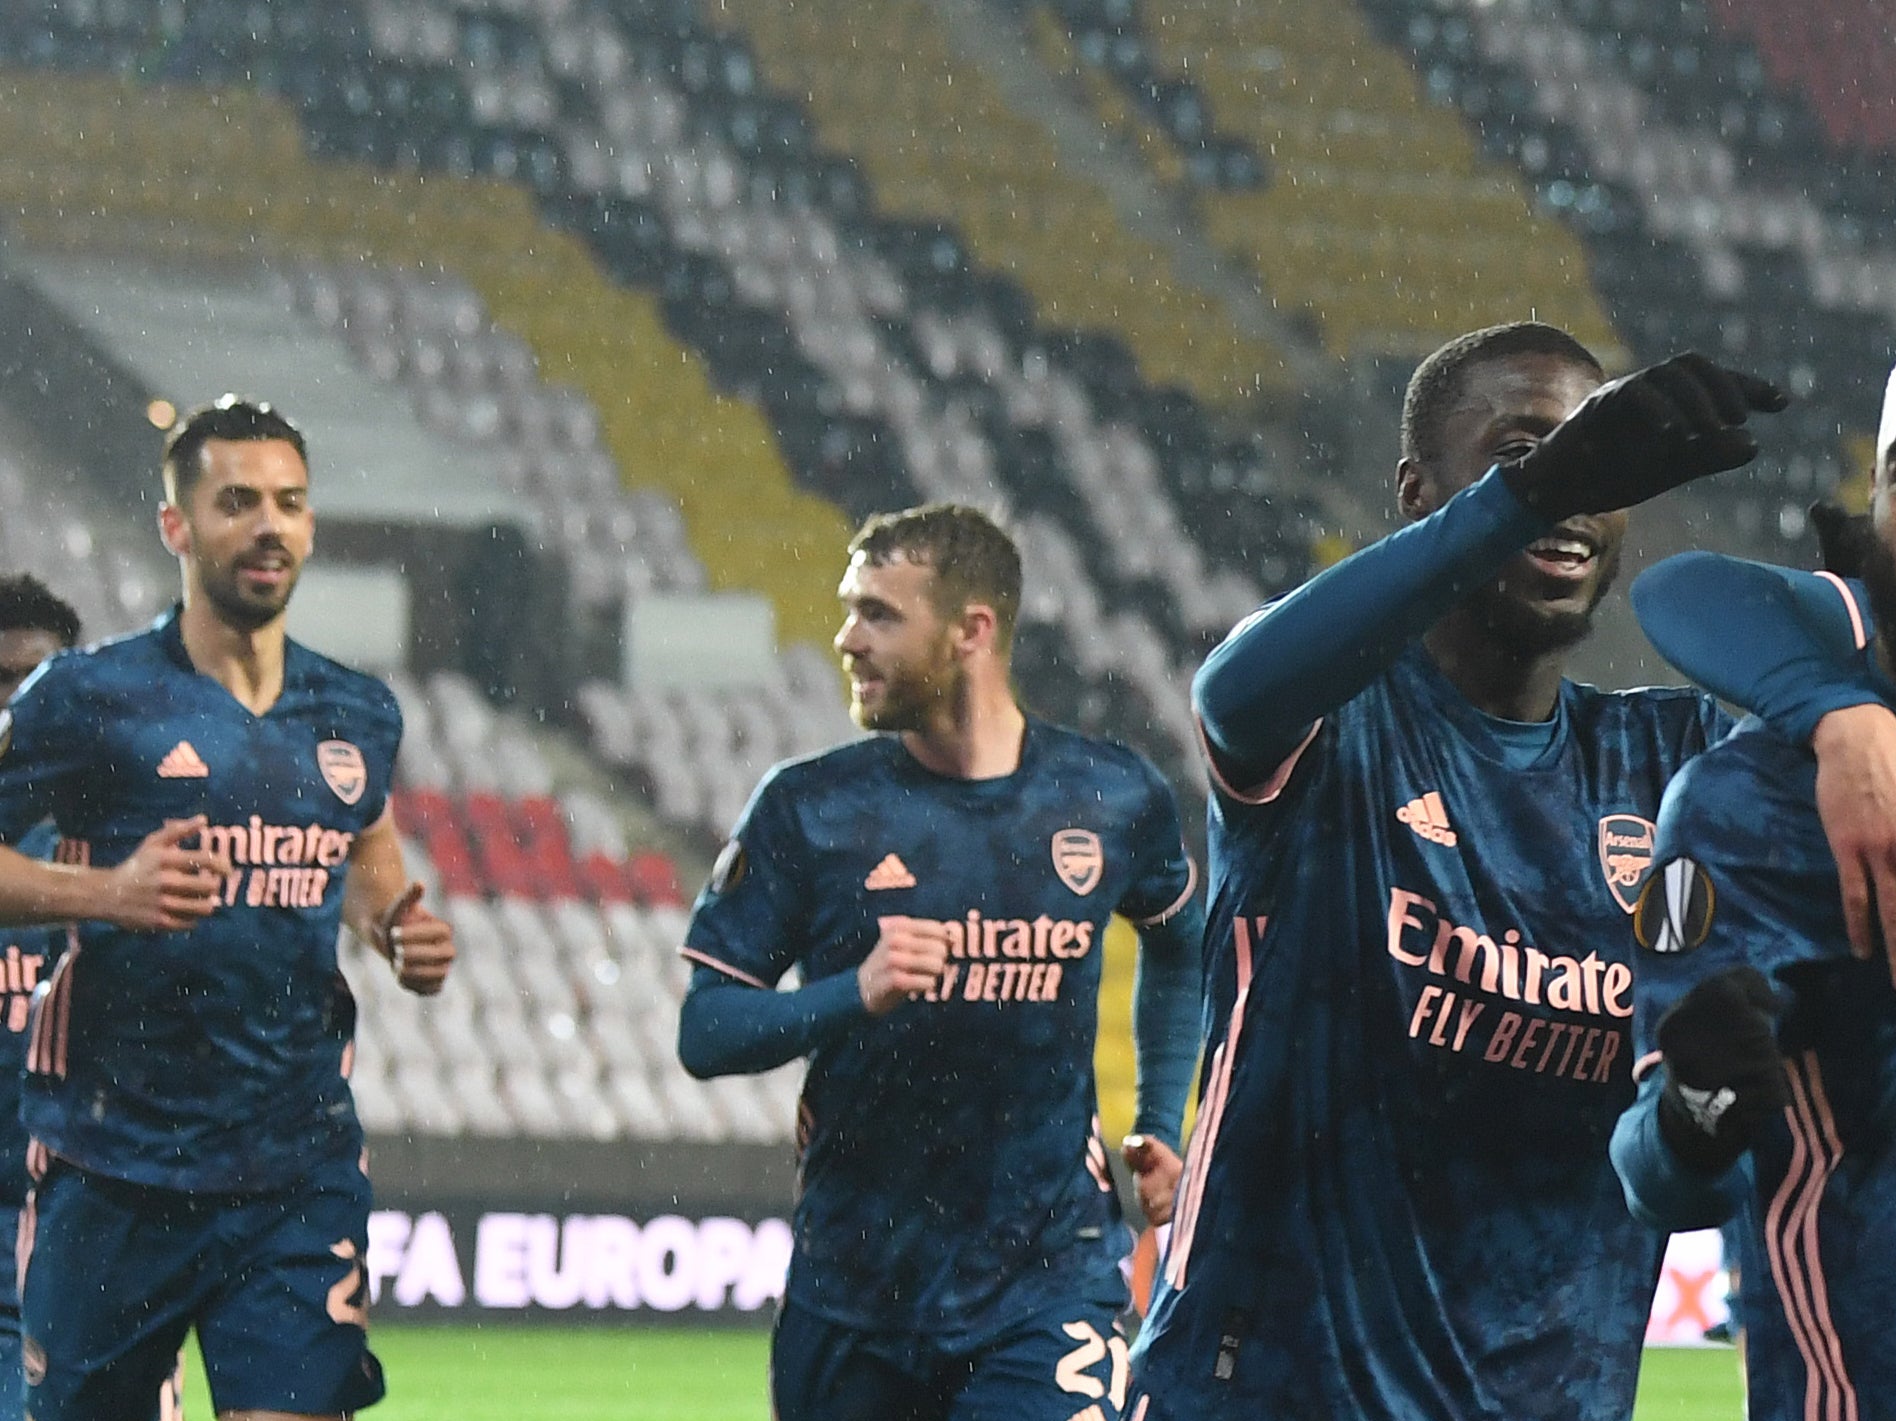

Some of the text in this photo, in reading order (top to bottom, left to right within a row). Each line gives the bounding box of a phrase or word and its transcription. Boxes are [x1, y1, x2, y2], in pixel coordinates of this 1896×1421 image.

[200, 815, 354, 867] mirates
[944, 908, 1094, 959] irates
[1387, 886, 1635, 1018] Emirate
[963, 962, 1063, 1002] BETTER
[1408, 984, 1620, 1084] FLY BETTER
[366, 1210, 795, 1312] FA EUROPA
[1055, 1320, 1132, 1412] 21
